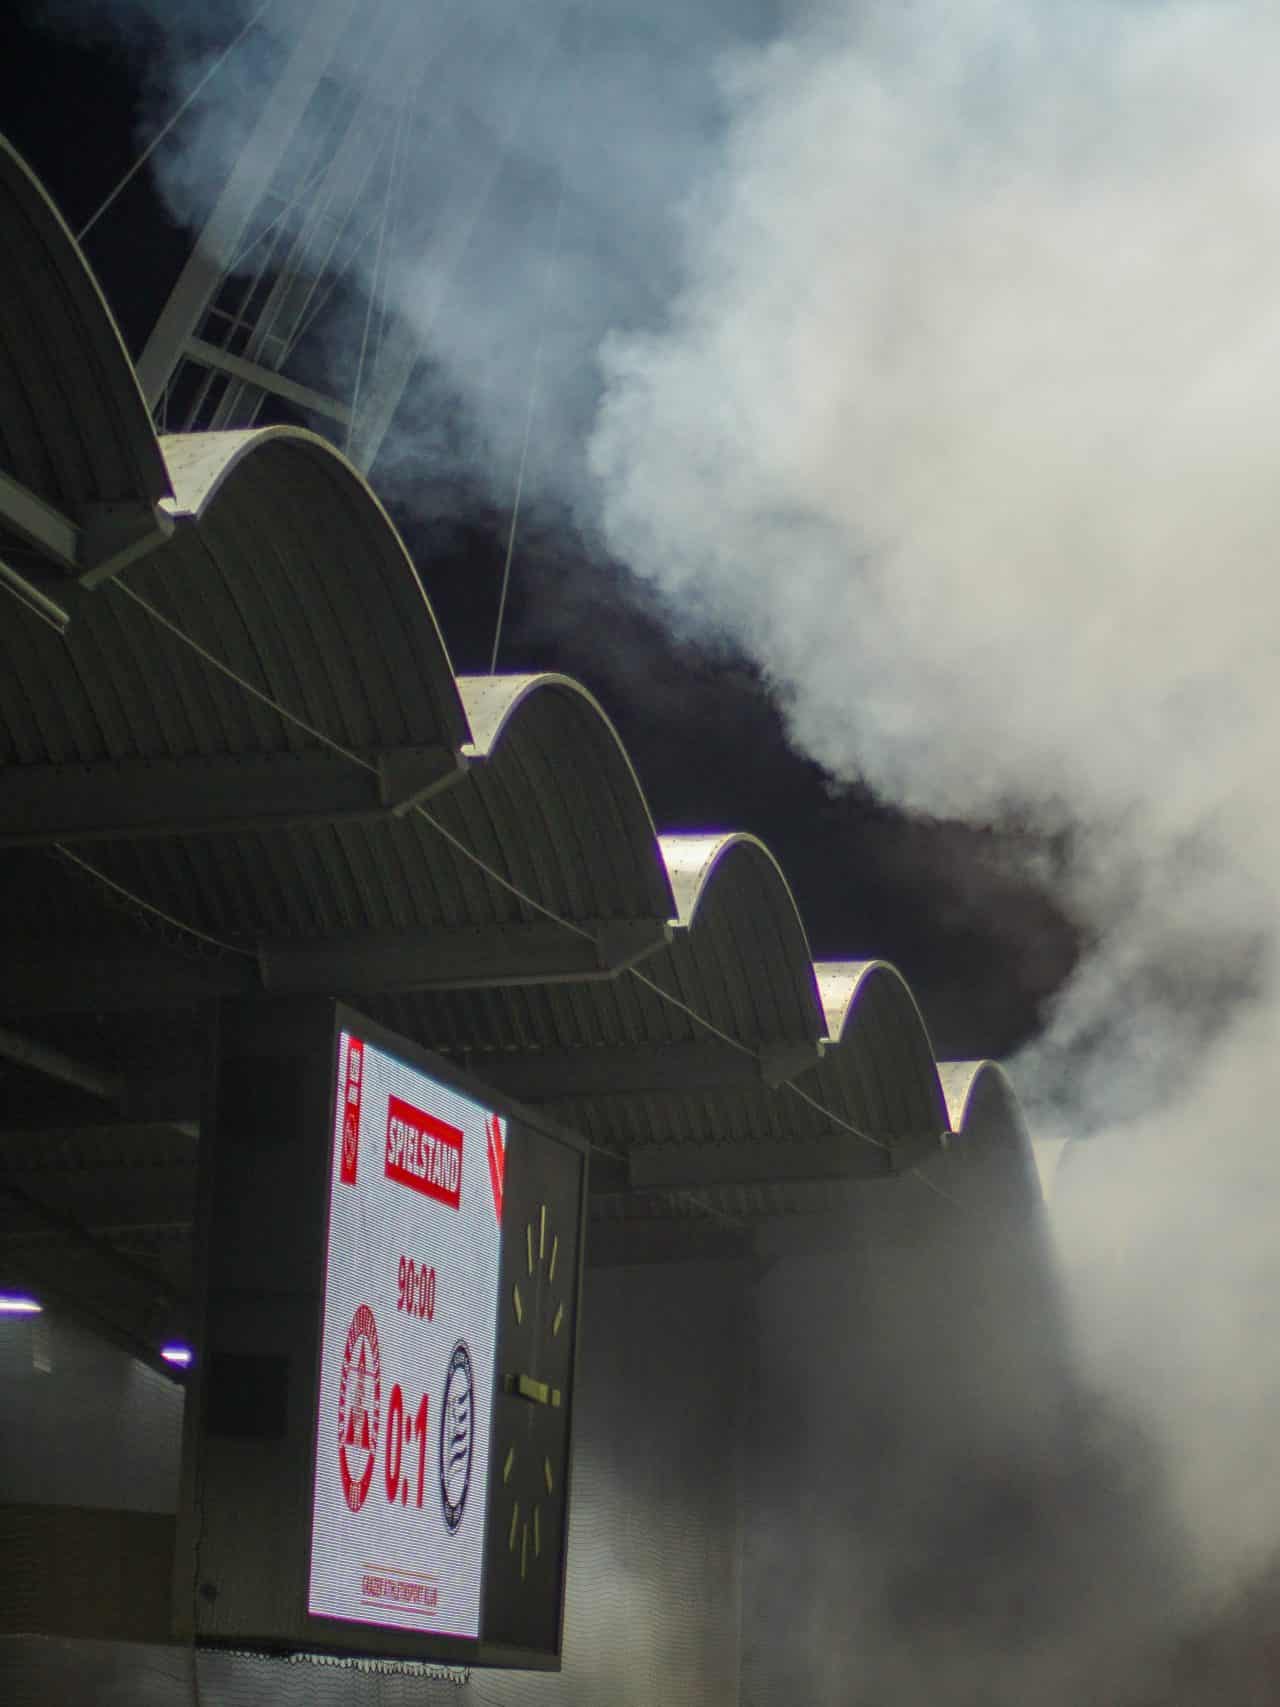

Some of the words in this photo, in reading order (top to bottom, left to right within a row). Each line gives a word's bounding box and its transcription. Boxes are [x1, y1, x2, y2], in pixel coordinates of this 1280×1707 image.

[387, 1116, 460, 1194] SPIELSTAND
[398, 1255, 435, 1322] 90:00
[385, 1383, 429, 1509] 0:1
